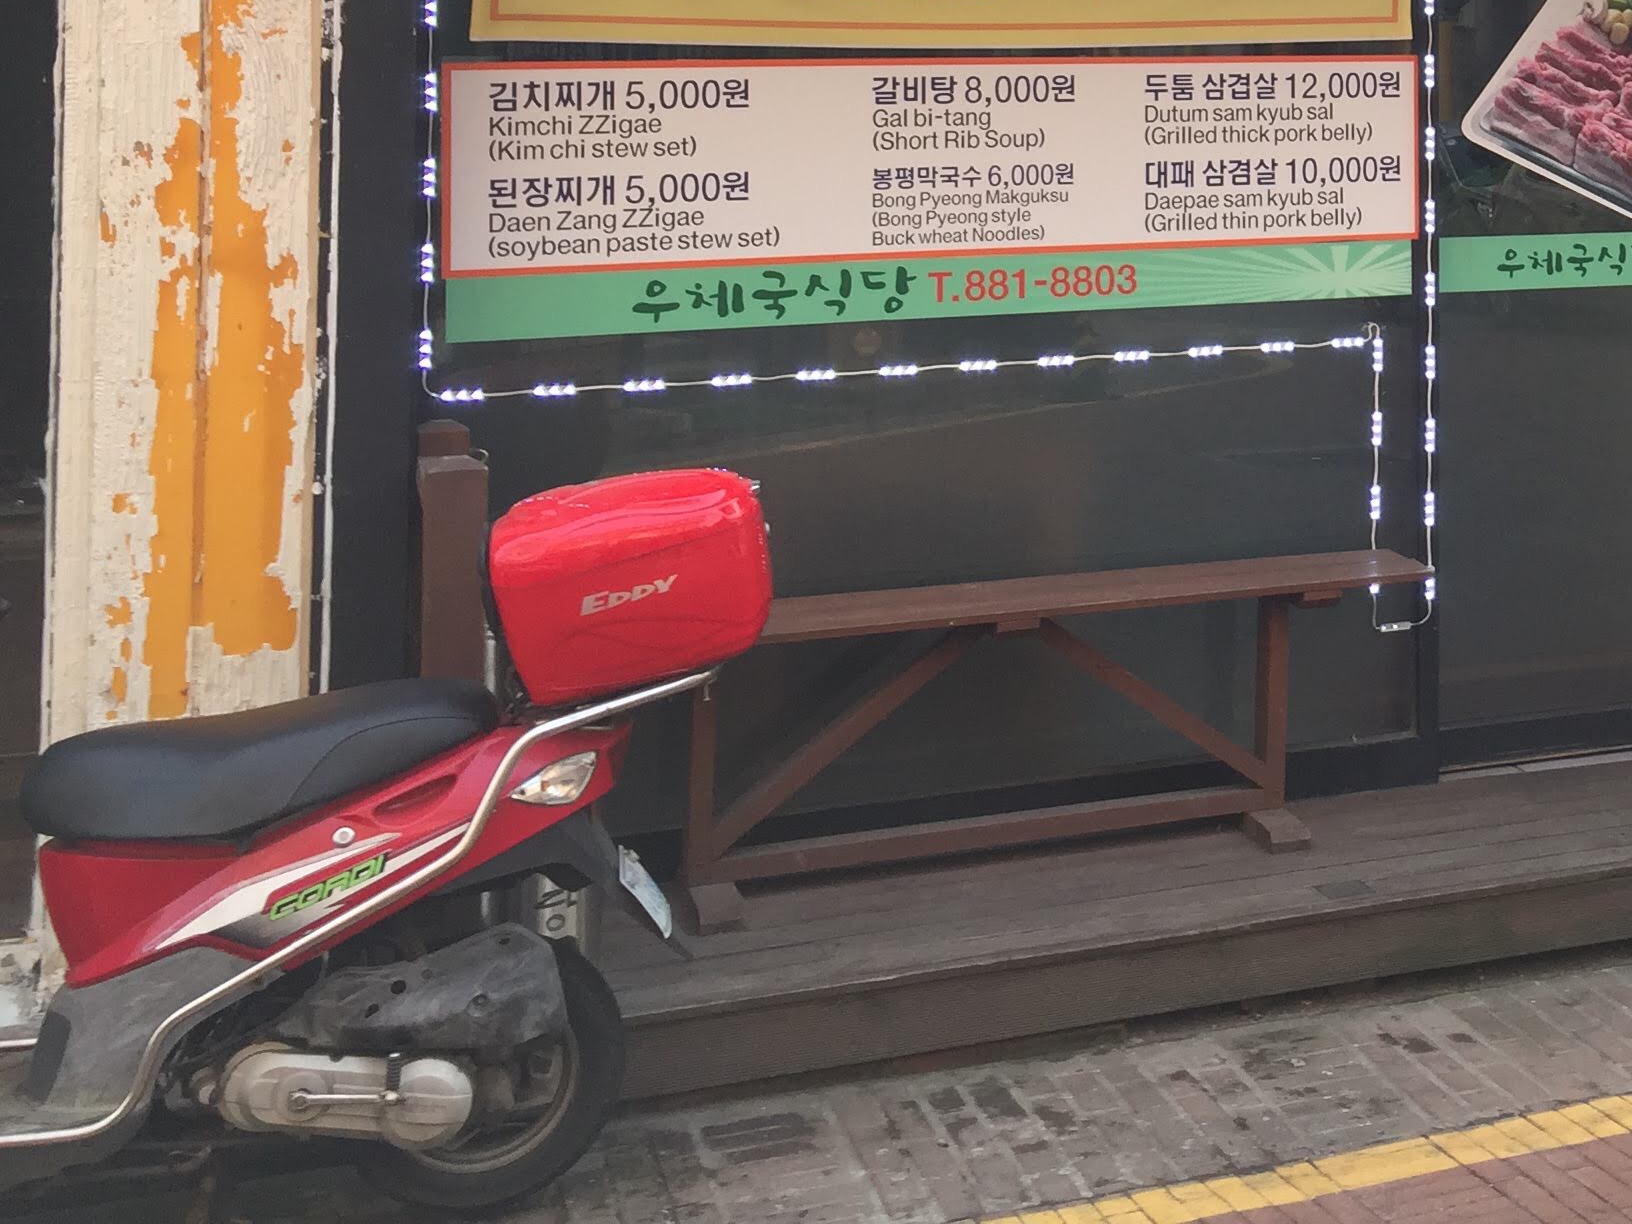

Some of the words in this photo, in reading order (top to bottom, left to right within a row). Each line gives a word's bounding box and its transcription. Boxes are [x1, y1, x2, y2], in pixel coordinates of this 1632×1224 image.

[489, 81, 616, 112] 김치찌개
[625, 78, 750, 112] 5,000원
[872, 76, 957, 105] 갈비탕
[965, 74, 1075, 107] 8,000원
[1145, 74, 1195, 101] 두툼
[1202, 73, 1278, 100] 삼겹살
[1286, 71, 1401, 102] 12,000원
[489, 116, 573, 136] Kimchi
[578, 114, 662, 137] ZZigae
[872, 109, 908, 128] Gal
[914, 107, 991, 130] bi-tang
[1145, 104, 1209, 123] Dutum
[1212, 107, 1252, 122] sam
[1257, 103, 1303, 124] kyub
[1306, 102, 1334, 120] sal
[872, 131, 939, 152] (Short
[944, 130, 980, 149] Rib
[985, 128, 1045, 152] Soup)
[1145, 125, 1217, 146] (Grilled
[1222, 123, 1270, 143] thick
[1274, 123, 1317, 146] pork
[1321, 122, 1373, 145] belly)
[489, 139, 545, 162] (Kim
[550, 139, 585, 160] chi
[591, 138, 648, 159] stew
[653, 136, 697, 158] set)
[872, 165, 982, 190] 봉평막국수
[988, 163, 1075, 190] 6,000원
[1145, 160, 1195, 189] 대패
[1286, 155, 1401, 187] 10,000원
[489, 175, 616, 209] 된장찌개
[625, 171, 750, 208] 5,000원
[872, 192, 916, 210] Bong
[920, 191, 982, 210] Pyeong
[985, 189, 1069, 207] Makguksu
[1145, 190, 1219, 213] Daepae
[1223, 192, 1263, 208] sam
[1267, 188, 1313, 211] kyub
[1317, 187, 1345, 204] sal
[489, 212, 551, 233] Daen
[556, 210, 617, 234] Zang
[622, 208, 705, 231] ZZigae
[872, 211, 922, 229] (Bong
[926, 209, 988, 228] Pyeong
[991, 207, 1032, 226] style
[1145, 212, 1218, 234] (Grilled
[1221, 210, 1259, 229] thin
[1263, 209, 1307, 232] pork
[1310, 206, 1363, 229] belly)
[489, 235, 601, 262] (soybean
[606, 232, 674, 257] paste
[678, 228, 733, 250] stew
[738, 226, 781, 248] set)
[872, 230, 915, 246] Buck
[919, 229, 968, 244] wheat
[972, 225, 1045, 243] Noodles)
[632, 265, 918, 324] 우체국식당
[927, 264, 1138, 303] T.881-8803
